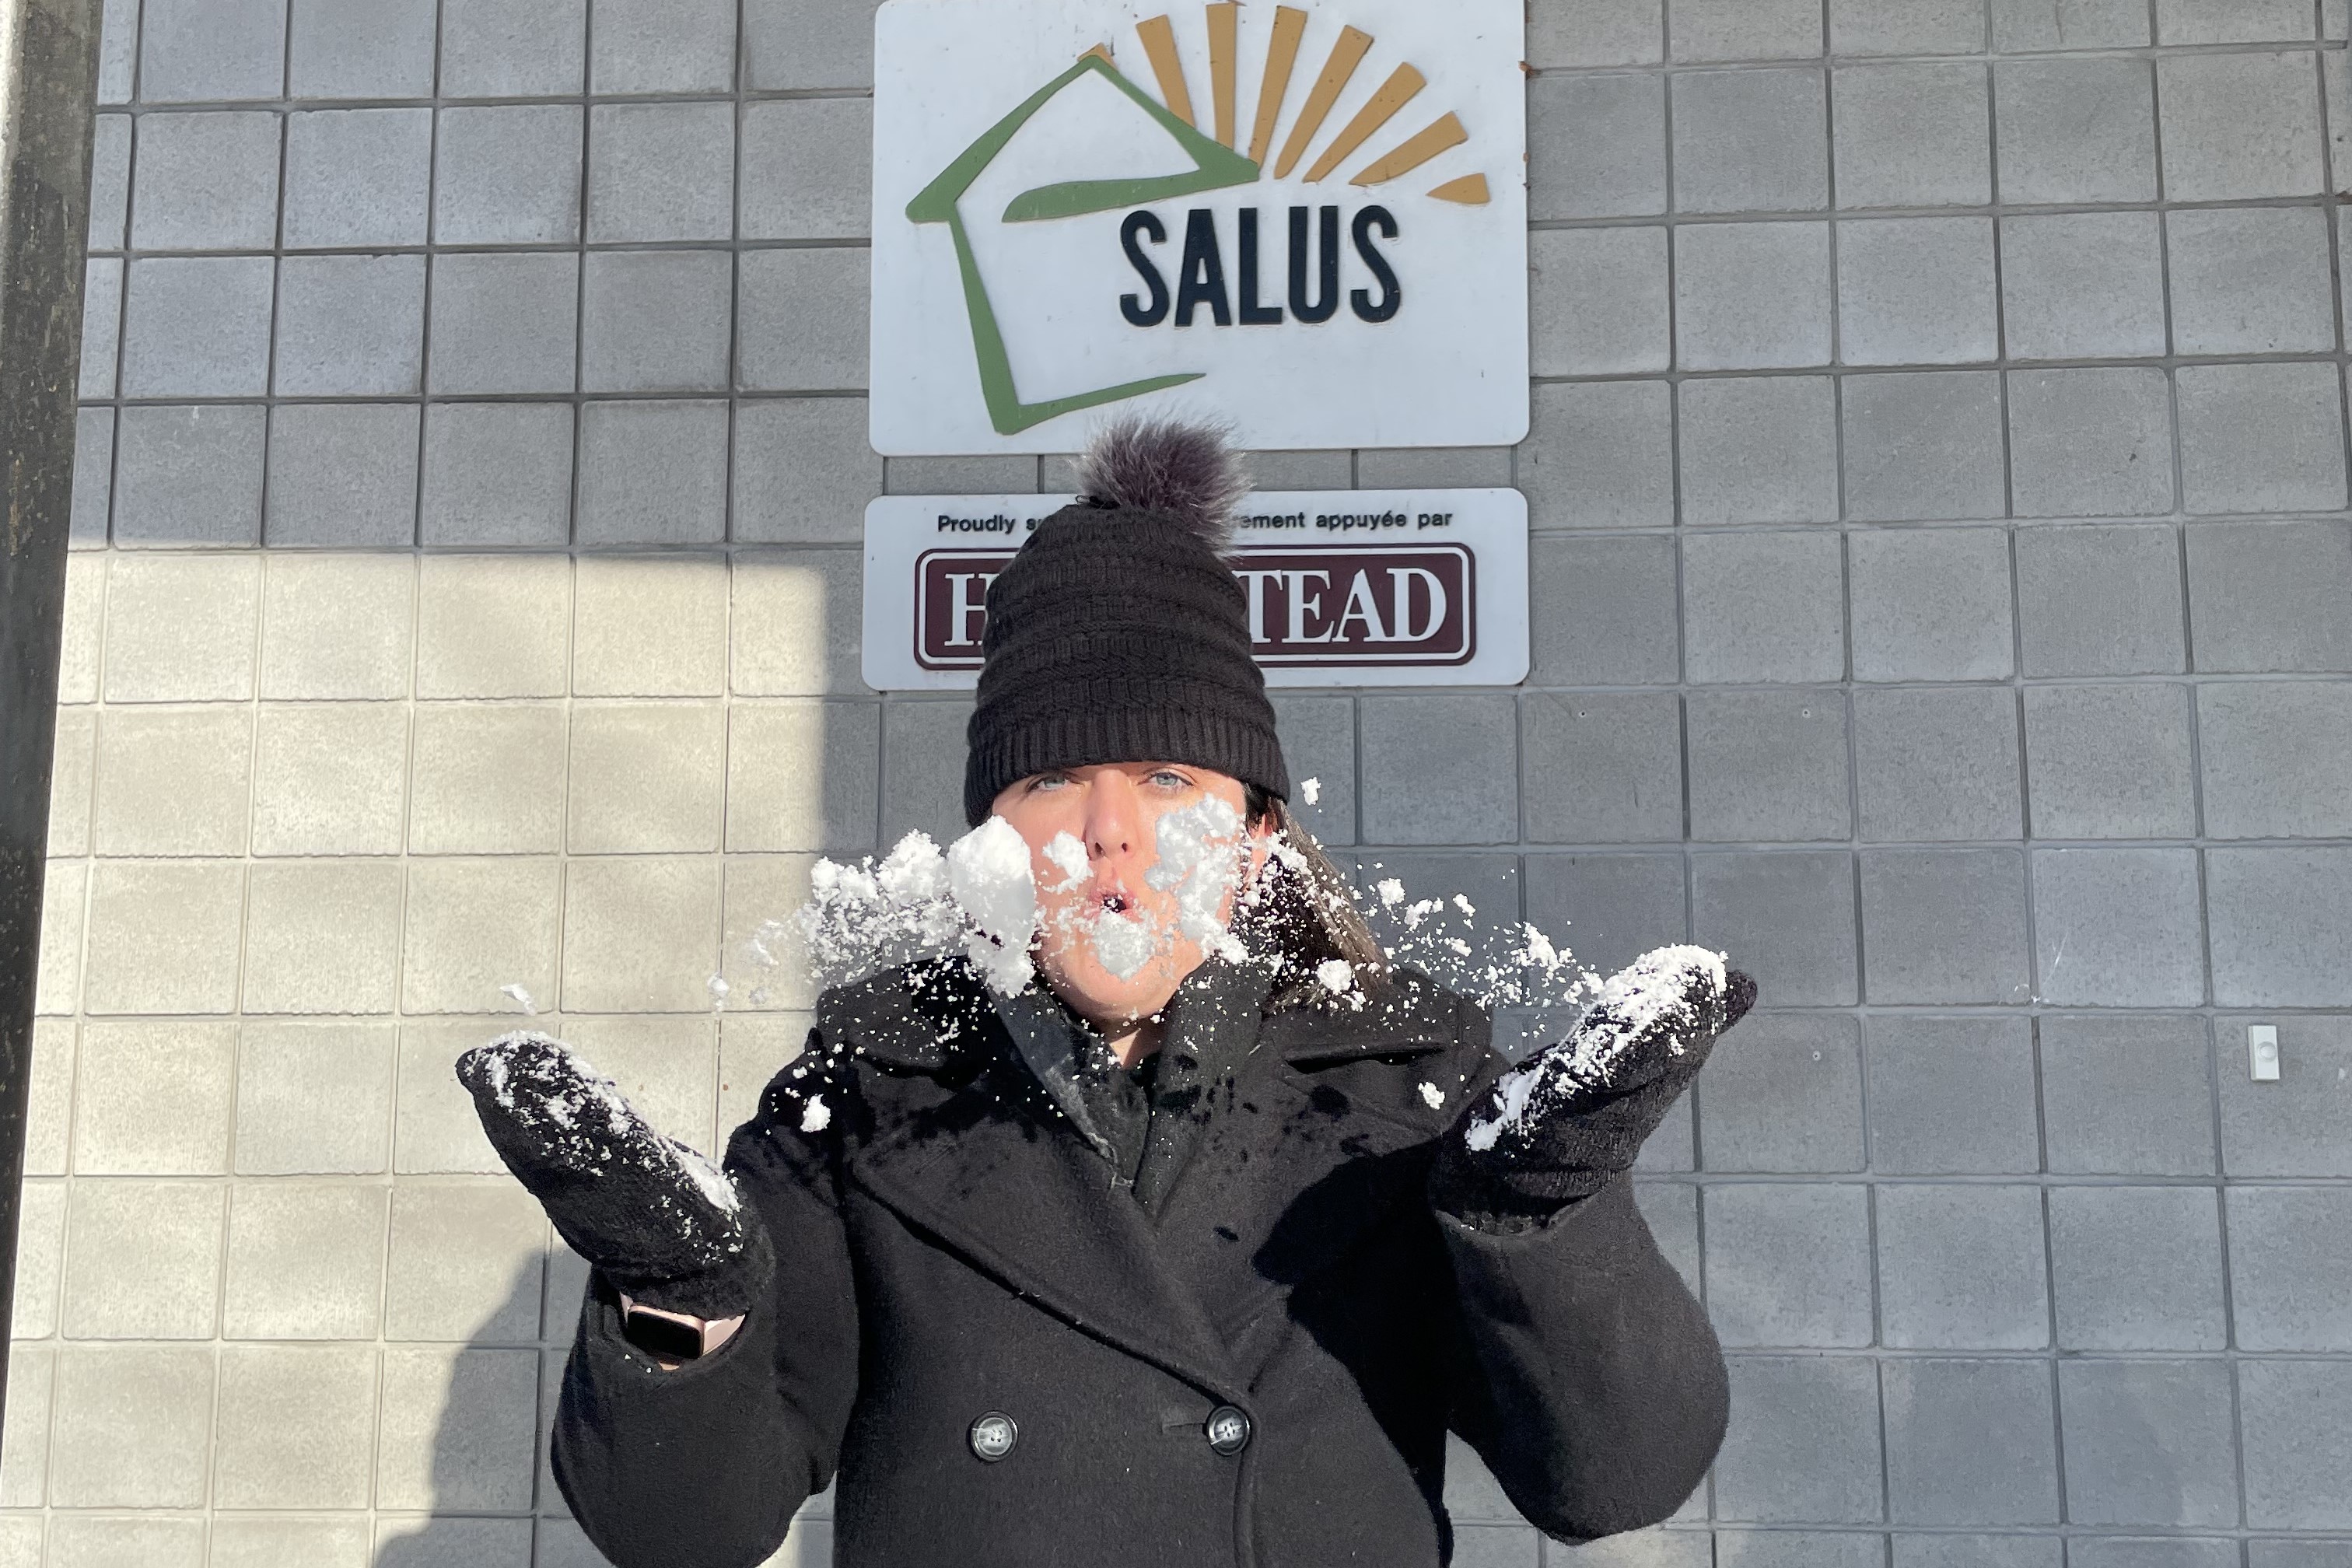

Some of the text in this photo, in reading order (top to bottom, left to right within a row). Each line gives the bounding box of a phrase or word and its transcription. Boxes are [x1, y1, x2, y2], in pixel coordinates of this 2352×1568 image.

[1120, 205, 1401, 327] SALUS
[938, 514, 1016, 534] Proudly
[1232, 510, 1453, 530] ement appuyée par
[944, 568, 1447, 646] HTEAD
